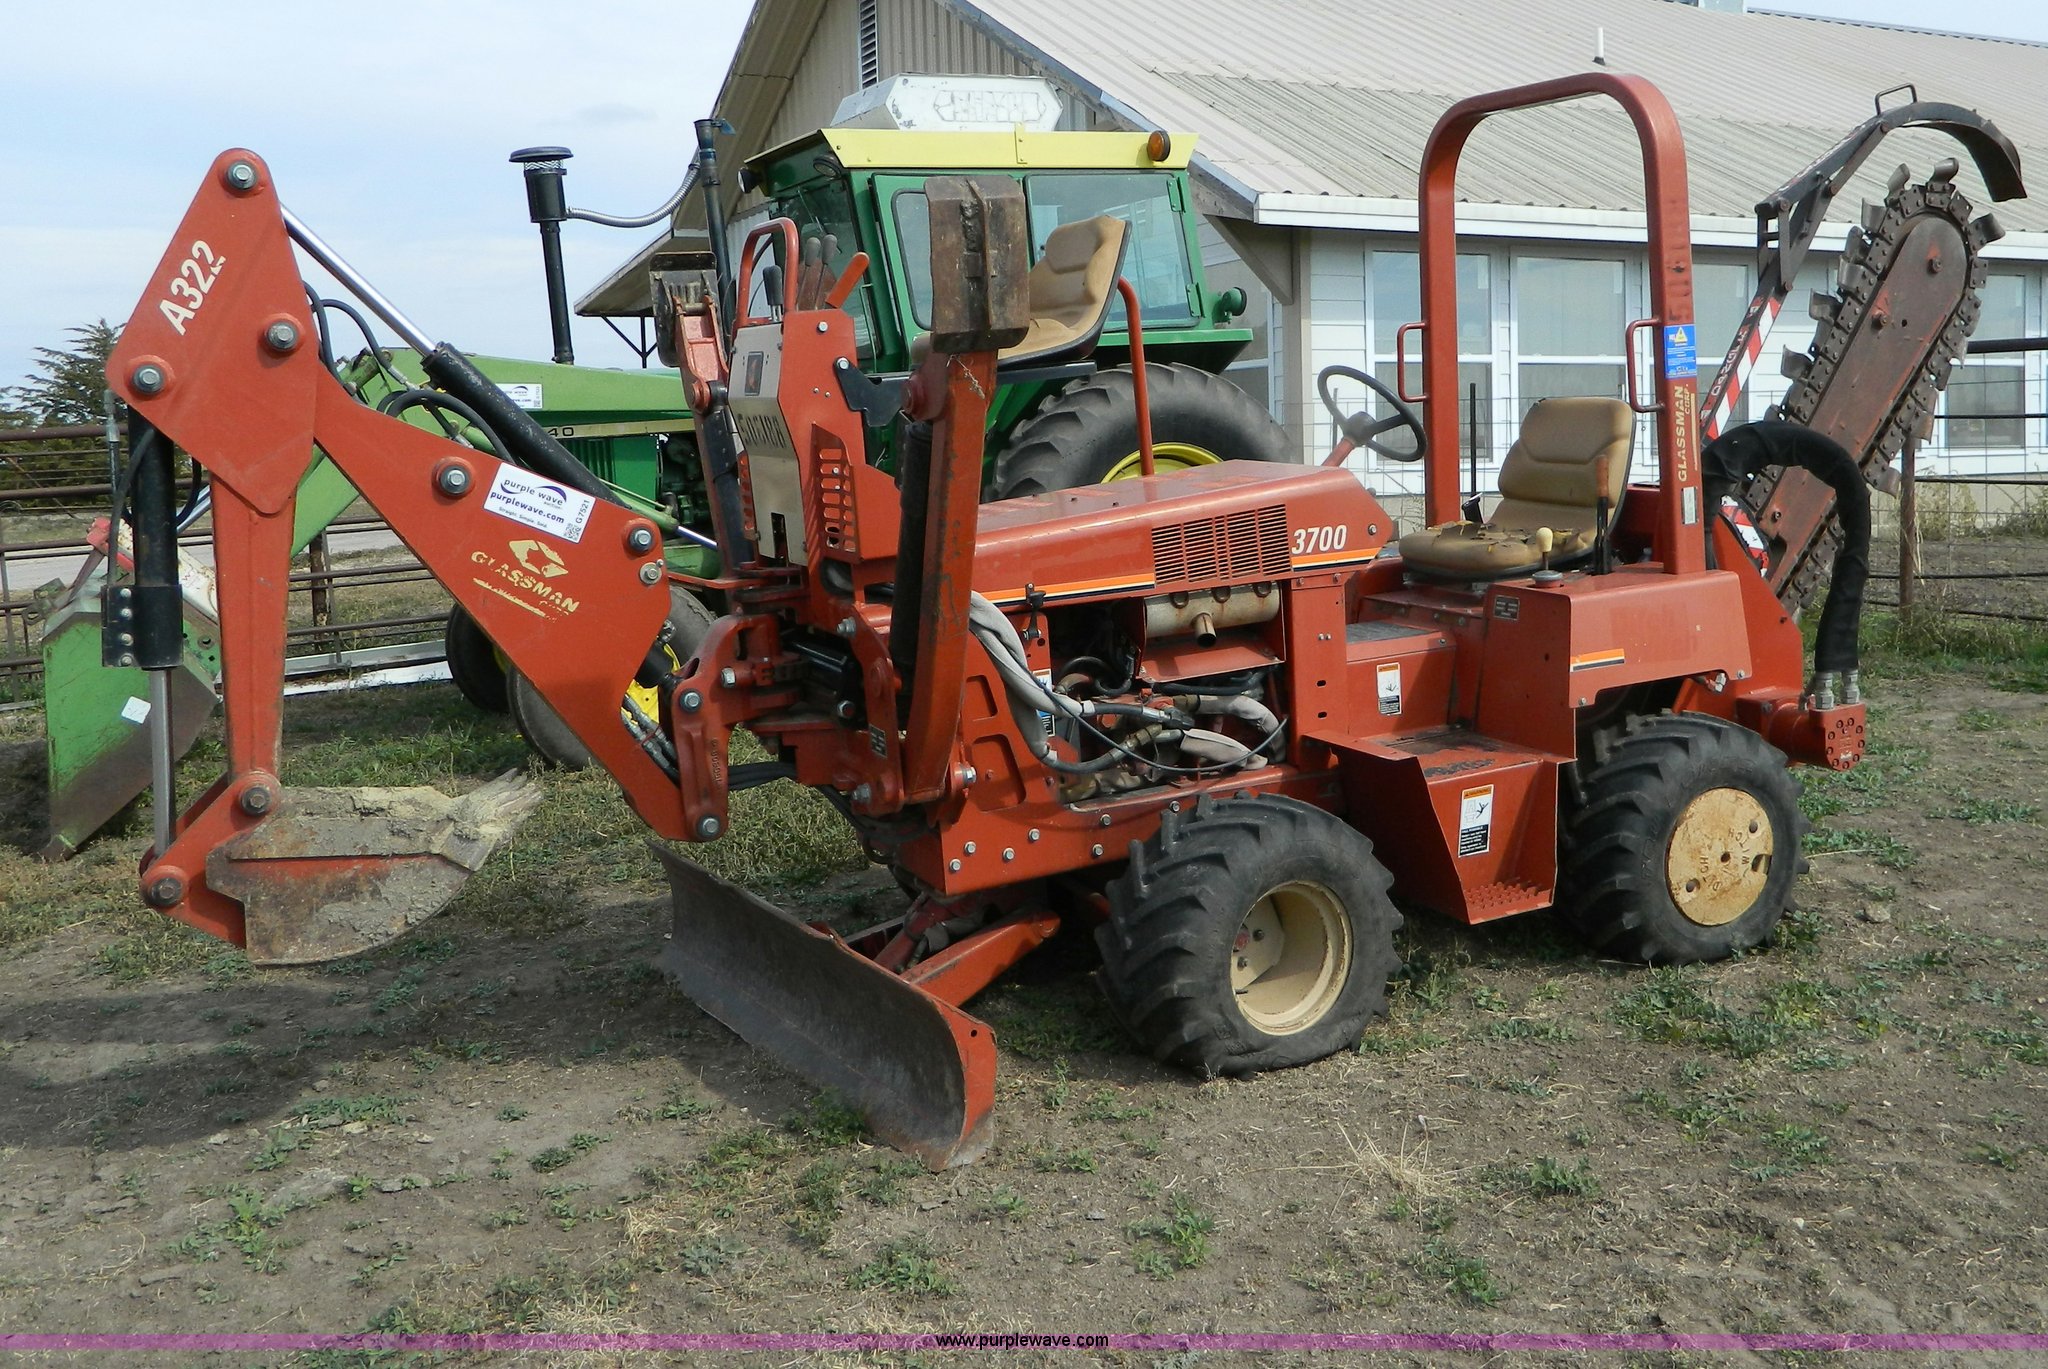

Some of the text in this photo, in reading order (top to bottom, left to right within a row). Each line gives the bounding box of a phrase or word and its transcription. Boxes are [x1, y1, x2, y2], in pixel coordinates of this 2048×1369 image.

[159, 240, 227, 336] A322
[1673, 386, 1688, 482] GLASSMAN
[490, 491, 565, 524] purplewave.com
[503, 479, 564, 506] purple wave
[575, 499, 590, 524] G7521
[1291, 524, 1348, 555] 3700
